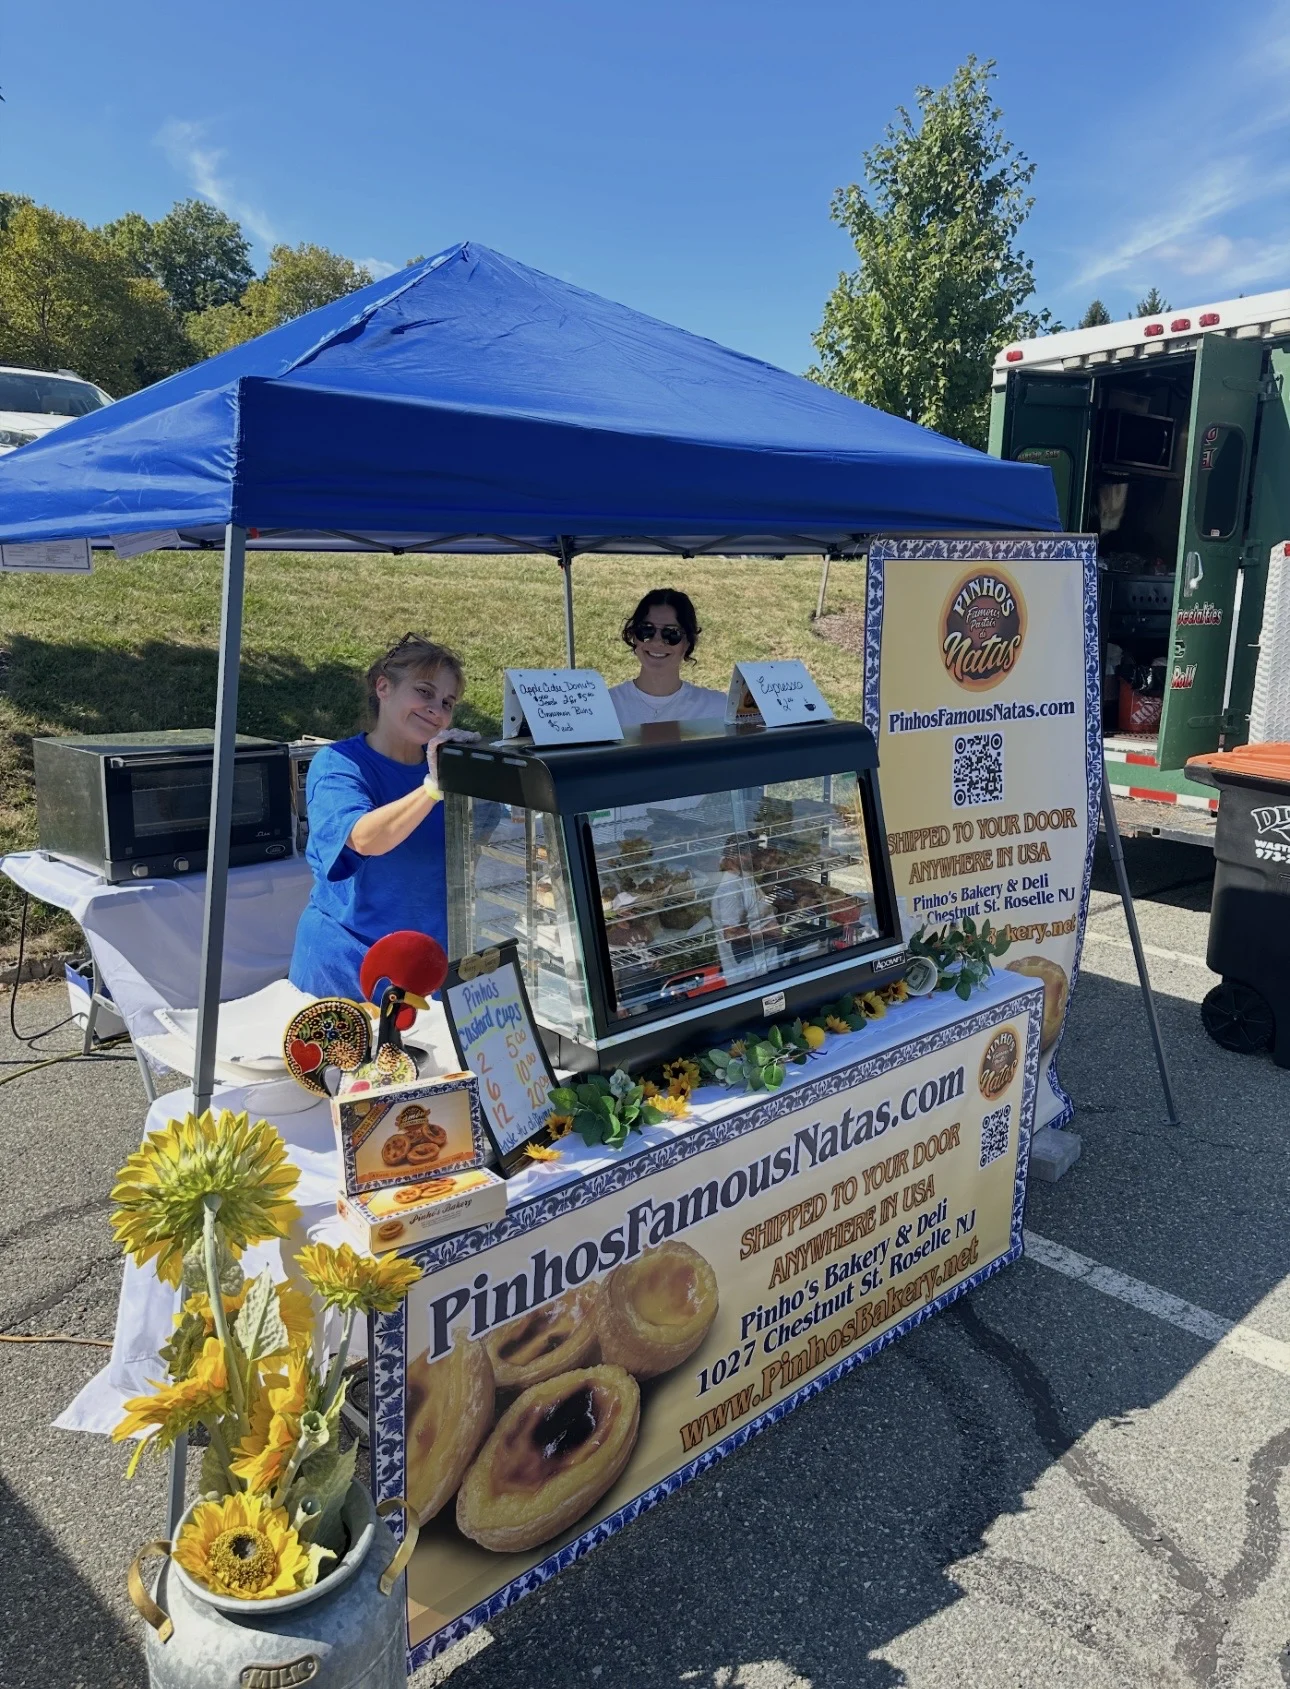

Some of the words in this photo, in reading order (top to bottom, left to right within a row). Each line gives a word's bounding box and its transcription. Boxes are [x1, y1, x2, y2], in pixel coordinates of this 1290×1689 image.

[953, 577, 1015, 617] PINHO'S
[966, 605, 1001, 623] Famous
[943, 631, 1022, 682] Natas
[563, 680, 595, 691] Donuts
[889, 700, 1075, 732] PinhosFamousNatas.com
[888, 823, 950, 856] SHIPPED
[953, 821, 974, 844] TO
[977, 814, 1020, 840] YOUR
[1024, 808, 1078, 833] DOOR
[908, 849, 994, 885] ANYWHERE
[996, 846, 1014, 867] IN
[1017, 841, 1052, 864] USA
[913, 887, 958, 912] Pinho's
[961, 882, 1003, 902] Bakery
[1006, 877, 1019, 893] &
[1022, 873, 1050, 891] Deli
[927, 903, 981, 926] Chestnut
[983, 899, 1000, 914] St.
[1004, 891, 1055, 911] Roselle
[1058, 887, 1076, 903] NJ
[462, 977, 500, 1013] Pinho's
[986, 1033, 1015, 1061] PINHO'S
[485, 1077, 501, 1101] 6
[979, 1059, 1018, 1098] Natas
[492, 1102, 514, 1129] 12
[739, 1193, 827, 1261] SHIPPED
[831, 1176, 858, 1211] TO
[863, 1149, 910, 1196] YOUR
[912, 1122, 961, 1171] DOOR
[428, 1064, 965, 1360] PinhosFamousNatas.com
[768, 1205, 877, 1290] ANYWHERE
[879, 1191, 899, 1226] IN
[902, 1174, 935, 1212] USA
[740, 1281, 819, 1341] Pinho's
[823, 1238, 891, 1292] Bakery
[895, 1222, 911, 1248] &
[916, 1198, 948, 1235] Deli
[696, 1340, 757, 1398] 1027
[763, 1282, 855, 1355] Chestnut
[859, 1268, 884, 1298] St.
[888, 1227, 952, 1279] Roselle
[955, 1208, 977, 1240] NJ
[679, 1235, 980, 1453] www.PinhosBakery.net
[248, 1661, 309, 1688] MILK
